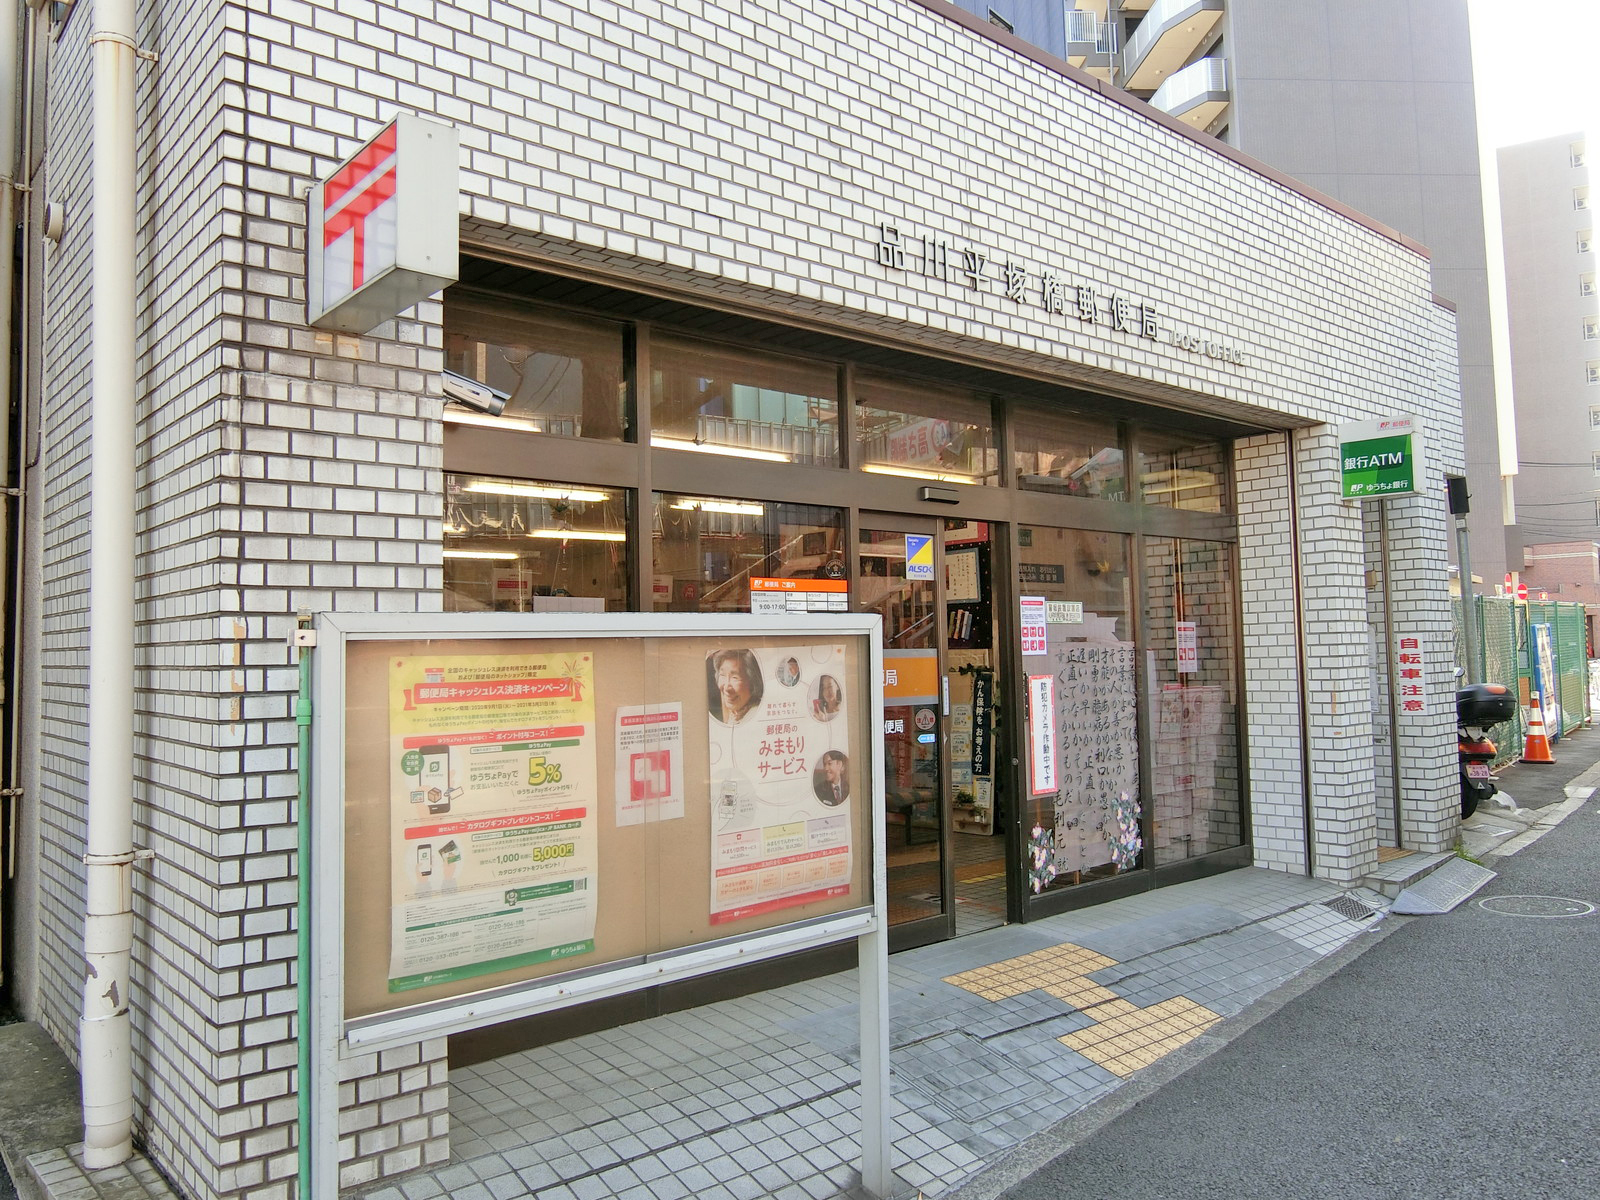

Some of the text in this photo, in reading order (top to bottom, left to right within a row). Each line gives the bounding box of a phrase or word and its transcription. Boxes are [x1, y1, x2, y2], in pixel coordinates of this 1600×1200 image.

[878, 221, 1160, 343] 品川平塚橋郵便局
[1170, 330, 1246, 366] POST OFFICE
[1344, 451, 1403, 470] 銀行ATM
[1366, 479, 1409, 491] ゆうちょ銀行
[908, 564, 933, 573] ALSOK
[1399, 637, 1424, 711] 自転車注意
[419, 683, 568, 699] 郵便局キャッシュレス決済キャンペーン
[766, 723, 798, 735] 郵便局の
[759, 736, 805, 756] みまもり
[470, 770, 519, 782] ゆうちょPayで
[528, 756, 562, 786] 5%
[757, 757, 807, 778] サービス
[470, 780, 519, 791] お支払いいただくと
